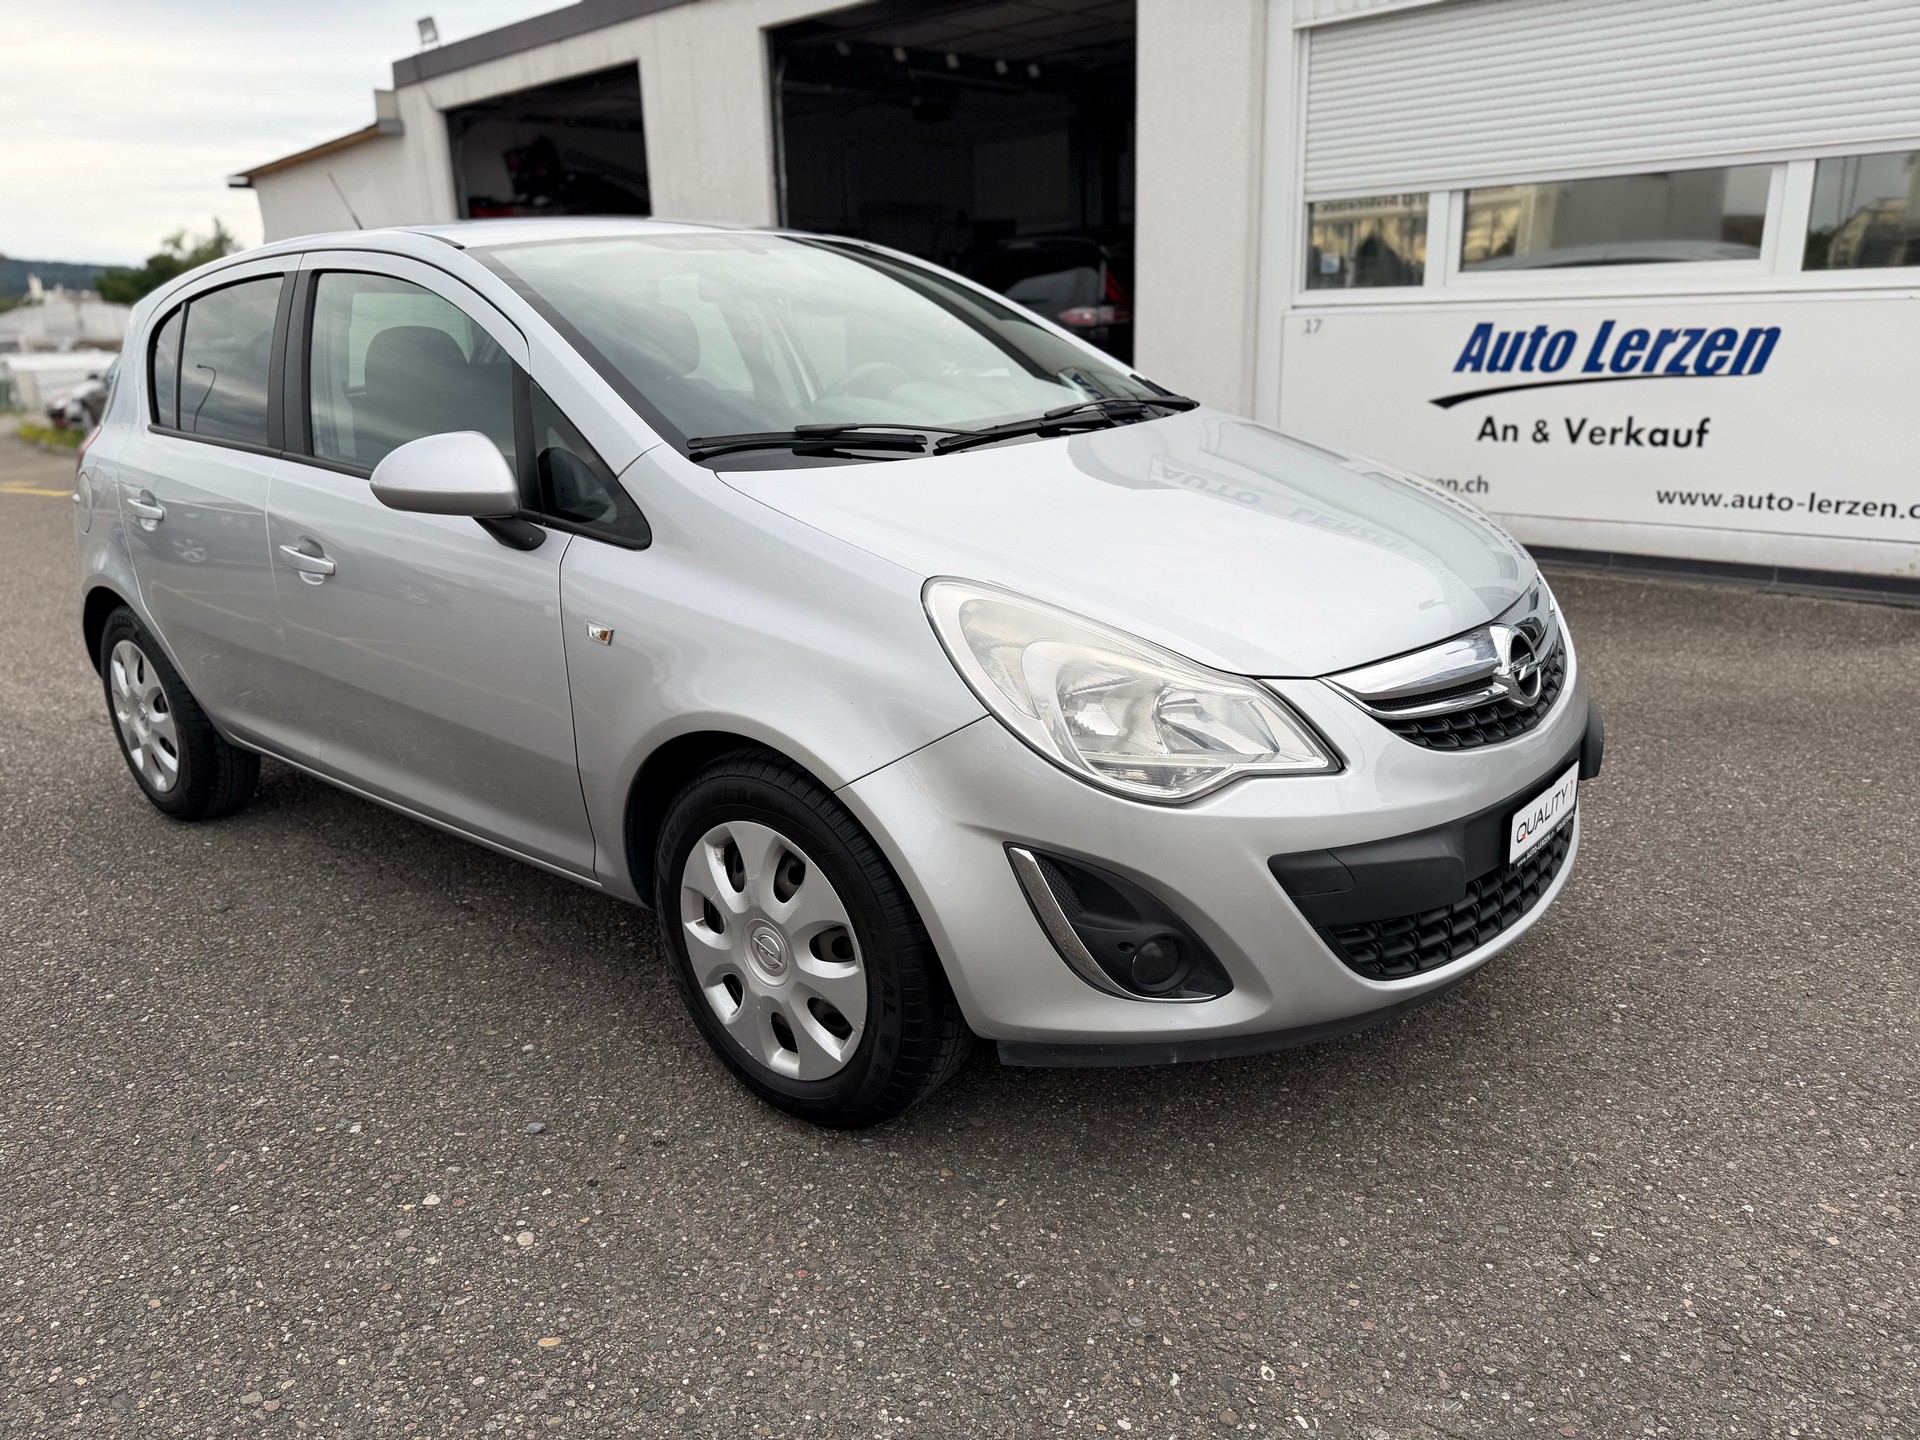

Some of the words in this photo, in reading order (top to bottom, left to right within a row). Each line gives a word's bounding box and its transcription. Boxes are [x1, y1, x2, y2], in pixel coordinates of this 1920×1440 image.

[1305, 318, 1323, 334] 17
[1453, 321, 1577, 375] Auto
[1582, 319, 1782, 377] Lerzen
[1476, 416, 1519, 443] An
[1531, 419, 1551, 443] &
[1564, 416, 1711, 449] Verkauf
[1517, 783, 1569, 843] QUALITY
